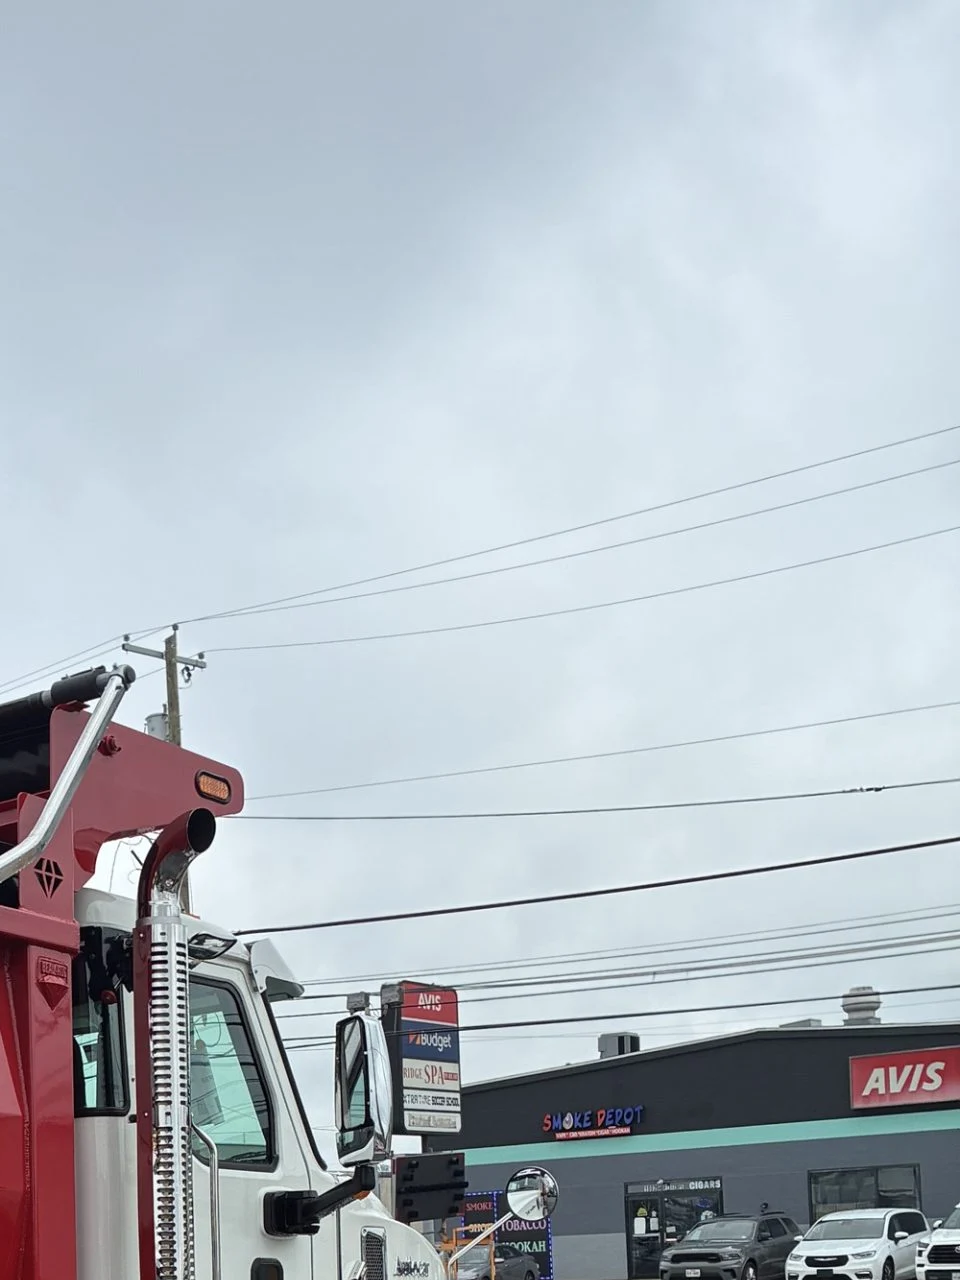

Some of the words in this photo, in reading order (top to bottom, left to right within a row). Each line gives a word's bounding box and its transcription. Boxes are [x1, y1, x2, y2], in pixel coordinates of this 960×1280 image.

[418, 992, 442, 1012] AVIS
[420, 1031, 452, 1052] budget
[424, 1064, 445, 1085] SPA
[861, 1061, 946, 1097] AVIS
[542, 1111, 592, 1131] SMOKE
[596, 1105, 643, 1127] DEPOT
[689, 1180, 721, 1190] CIGARS
[466, 1202, 493, 1212] SMOKE
[501, 1218, 547, 1231] TOBACCO
